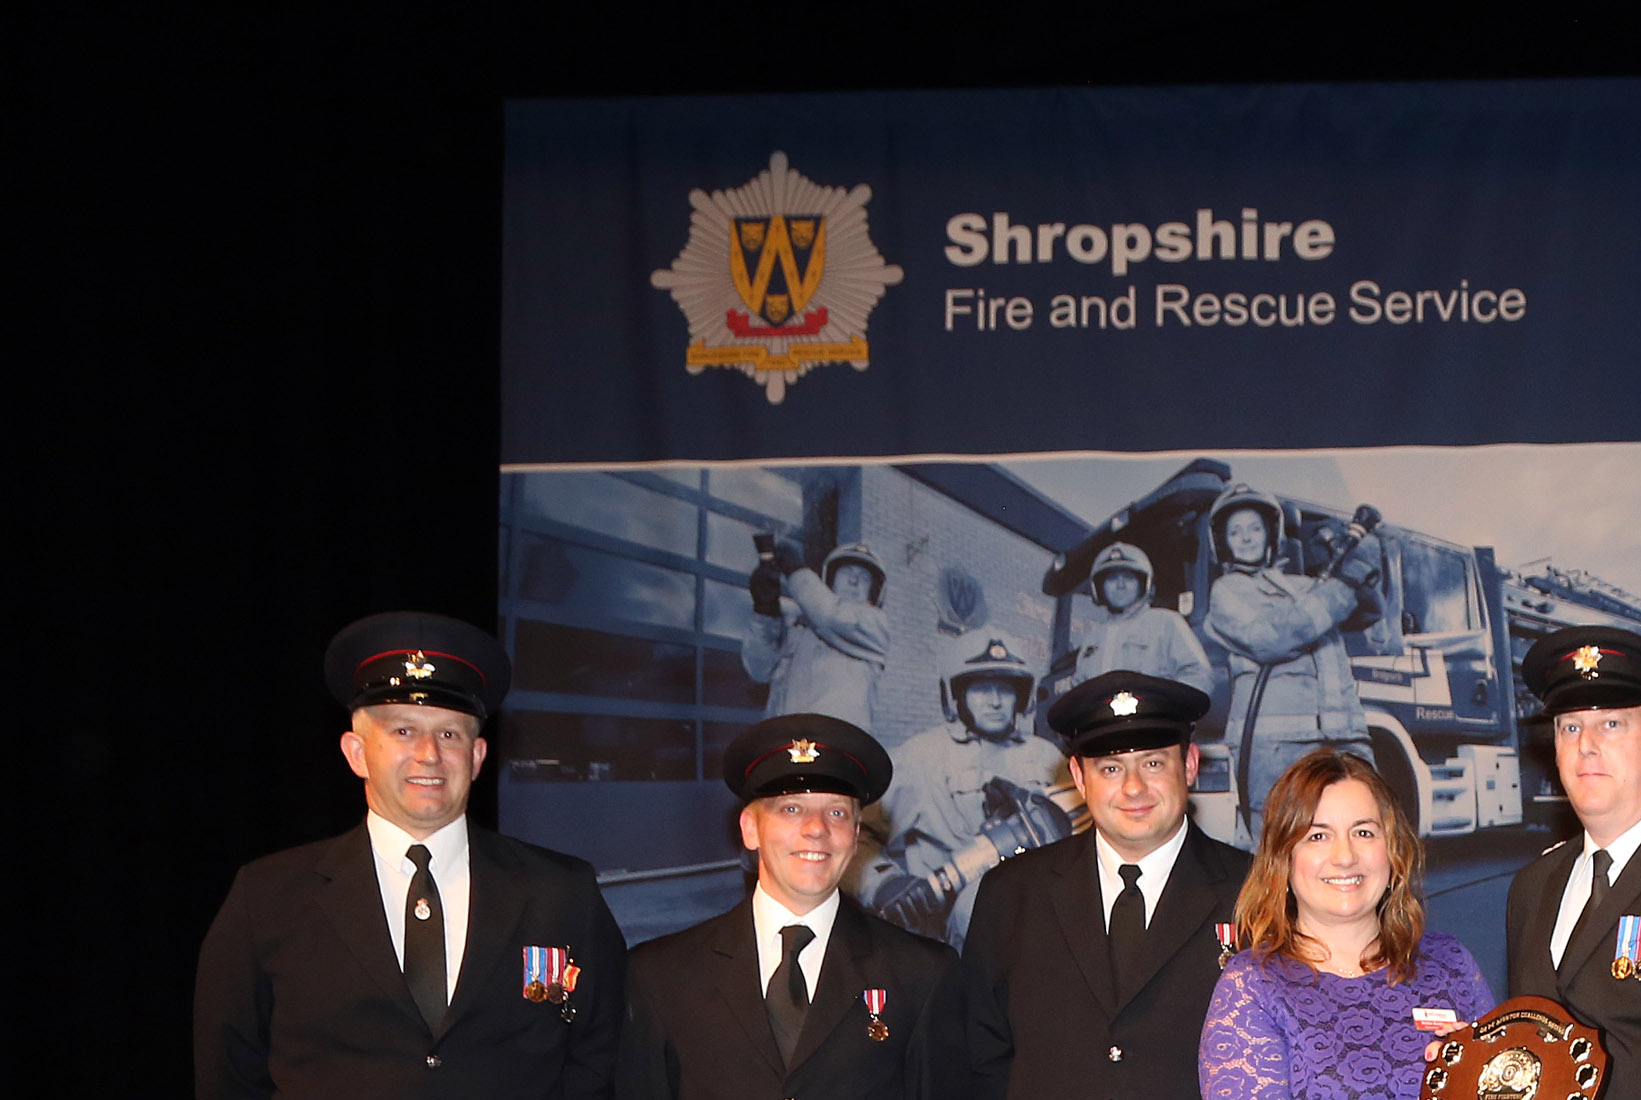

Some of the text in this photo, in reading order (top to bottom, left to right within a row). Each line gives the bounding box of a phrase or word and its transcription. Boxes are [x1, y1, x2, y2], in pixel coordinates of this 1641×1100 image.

[944, 207, 1336, 277] Shropshire
[944, 279, 1527, 331] Fire and Rescue Service
[1416, 706, 1455, 720] Rescue
